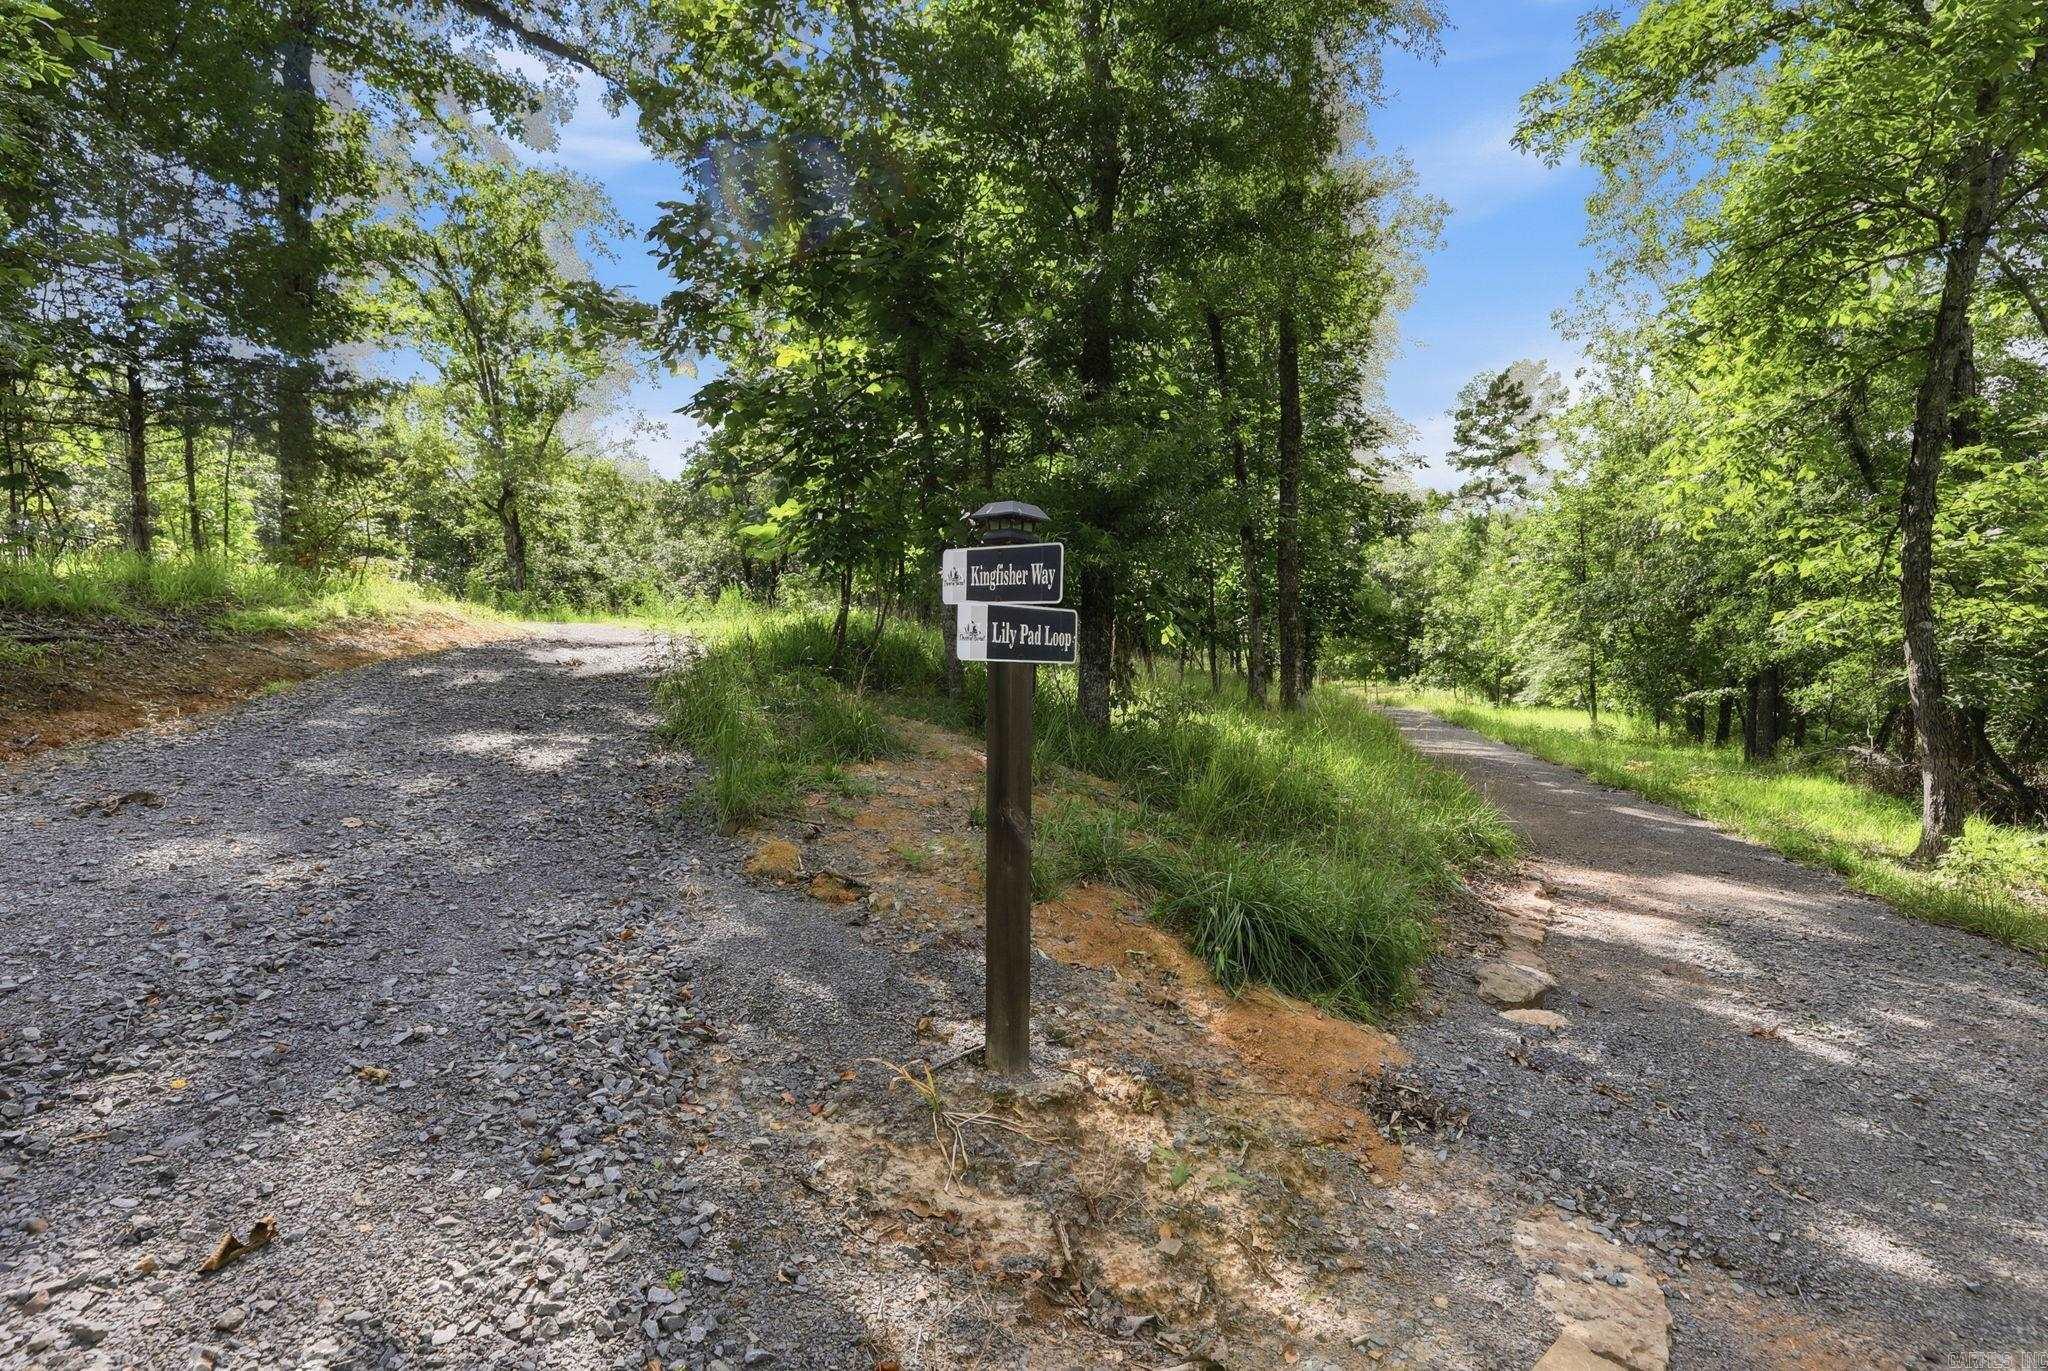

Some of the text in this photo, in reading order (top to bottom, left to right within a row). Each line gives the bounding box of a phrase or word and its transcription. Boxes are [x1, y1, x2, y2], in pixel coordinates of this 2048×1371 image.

[971, 563, 1056, 590] Kingfisher Way
[992, 622, 1071, 652] Lily Pad Loop
